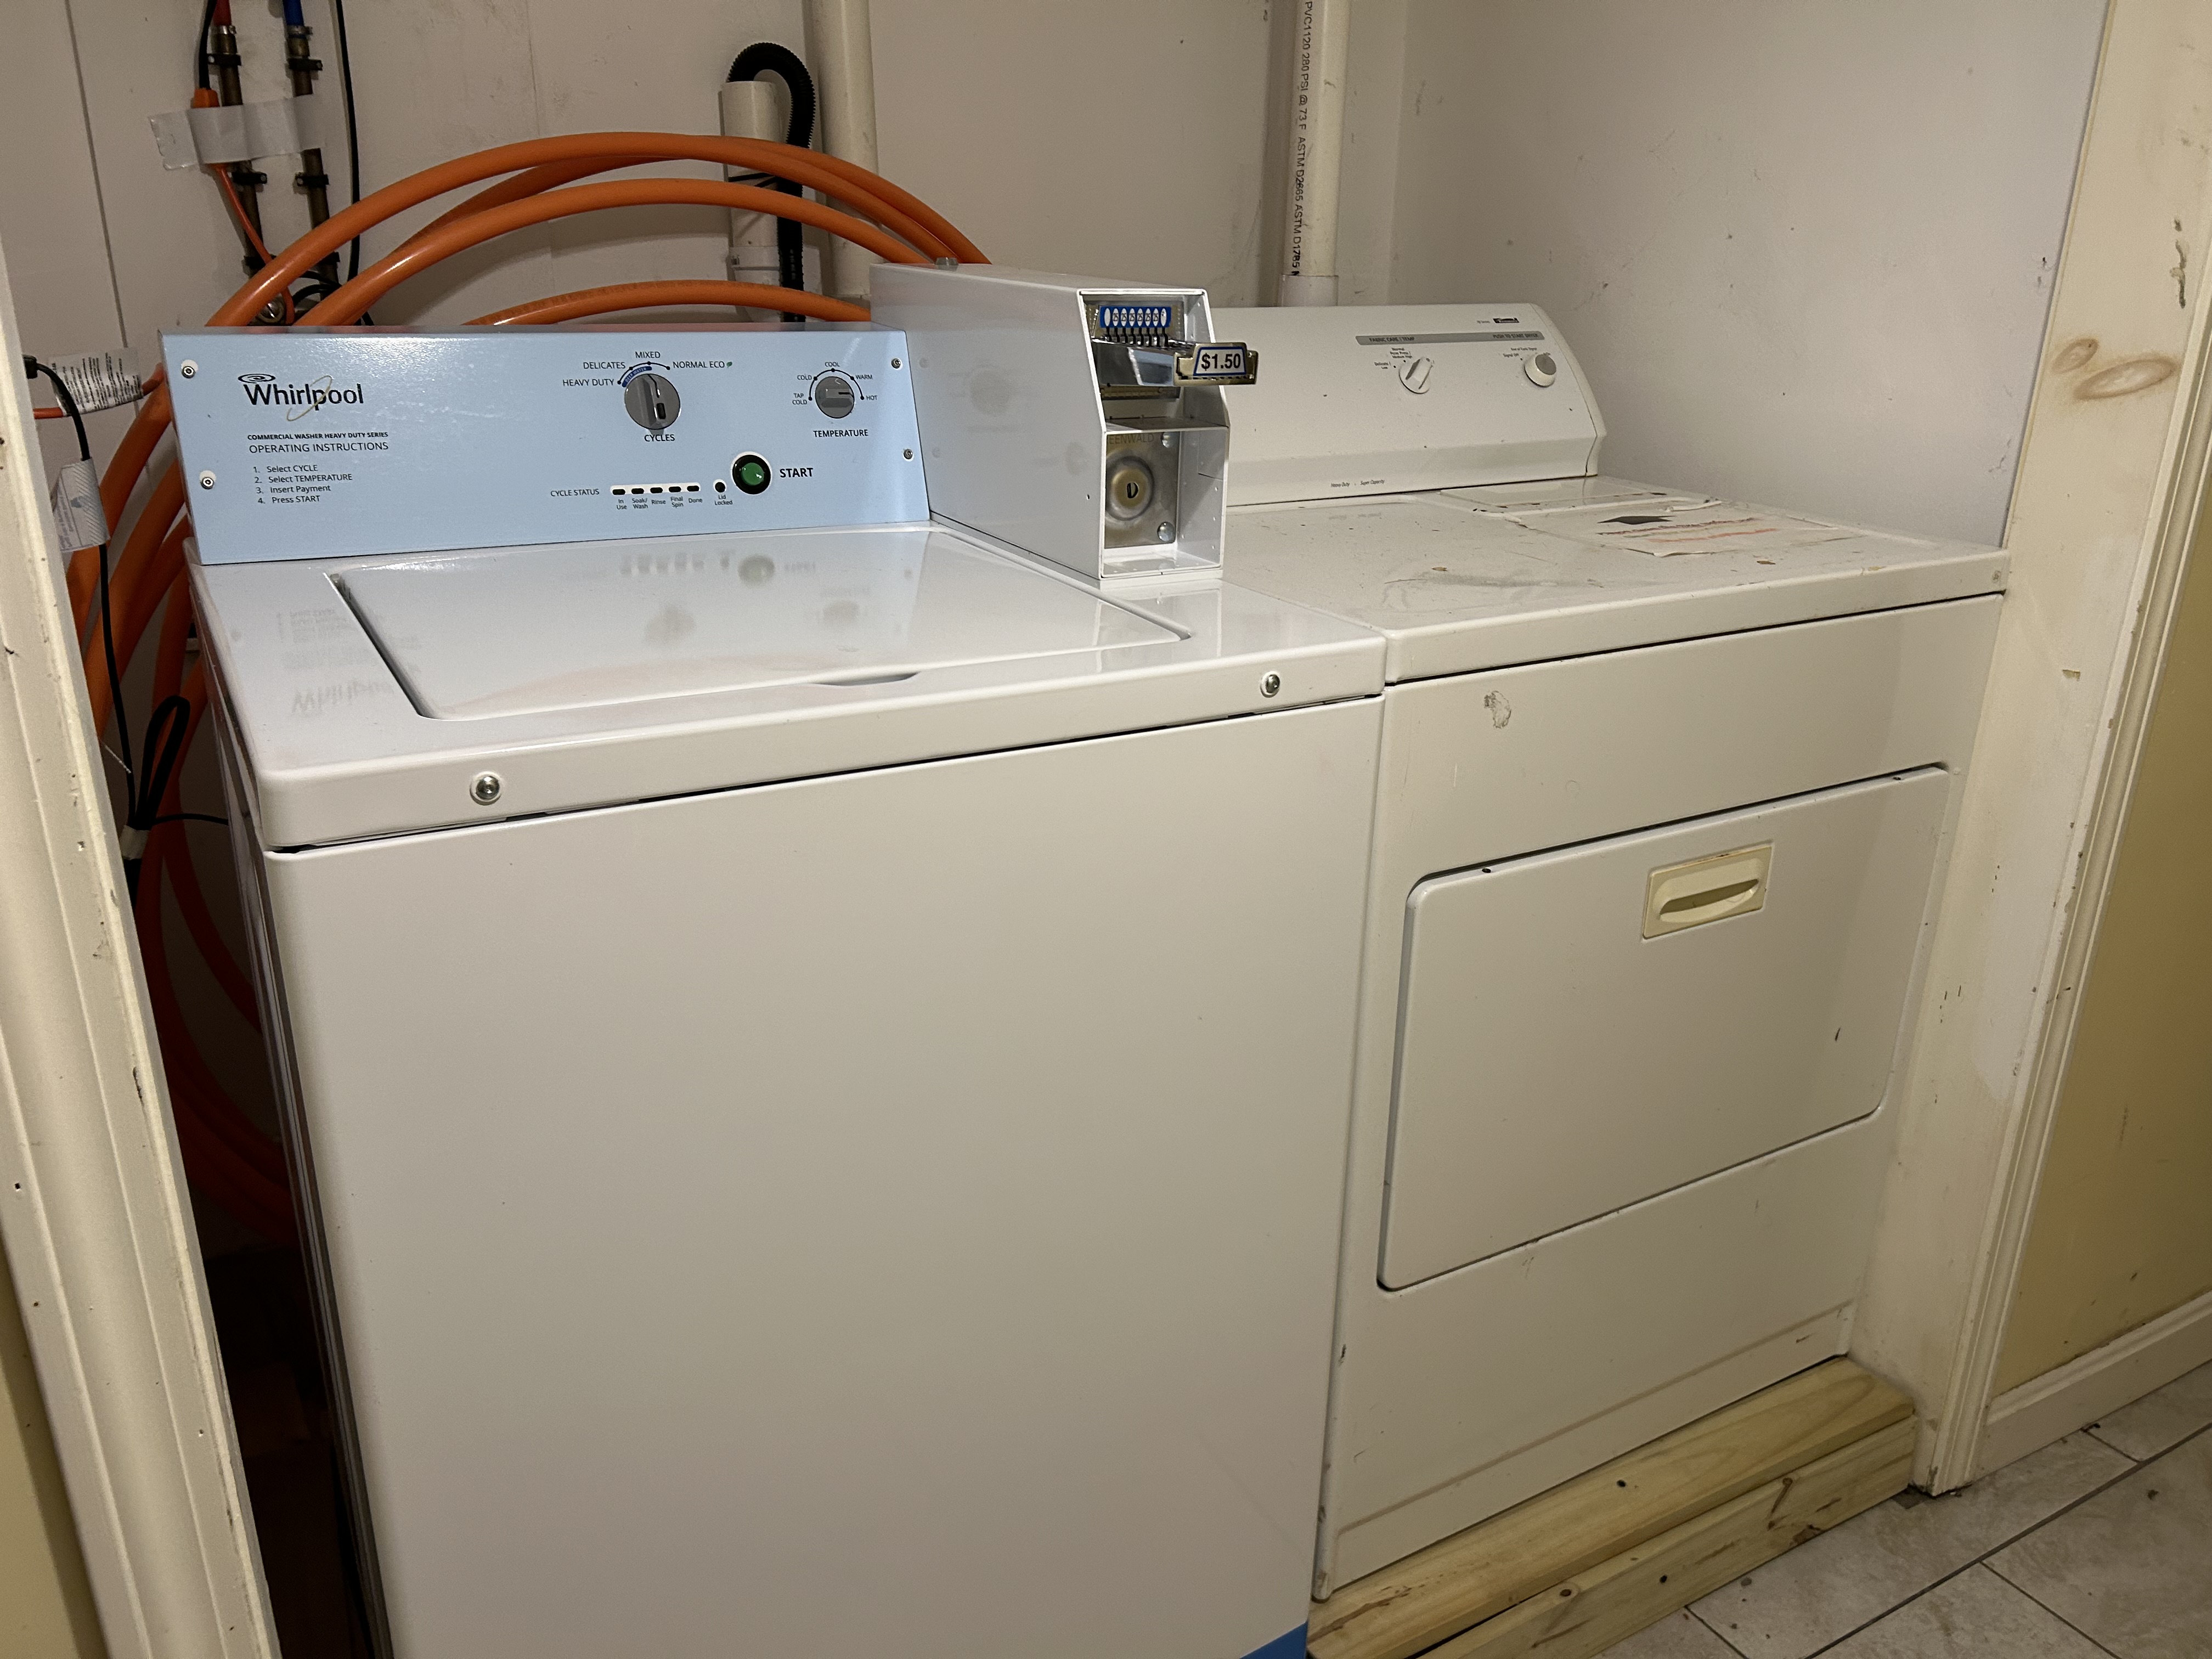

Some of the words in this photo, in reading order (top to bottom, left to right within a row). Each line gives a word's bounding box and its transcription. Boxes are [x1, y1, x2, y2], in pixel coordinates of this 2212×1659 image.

[1302, 1, 1313, 50] PVC1120
[1302, 53, 1310, 71] 280
[1301, 74, 1309, 91] PSI
[1299, 108, 1307, 121] 73
[1297, 137, 1306, 167] ASTM
[1294, 204, 1302, 234] ASTM
[1292, 236, 1301, 268] D1785
[1201, 353, 1241, 371] $1.50
[243, 382, 364, 411] Whirlpool
[644, 434, 675, 442] CYCLES
[813, 429, 869, 437] TEMPERATURE
[249, 443, 310, 454] OPERATING
[313, 442, 388, 452] INSTRUCTIONS
[294, 473, 353, 482] TEMPERATURE
[780, 467, 814, 478] START
[296, 484, 331, 494] Payment
